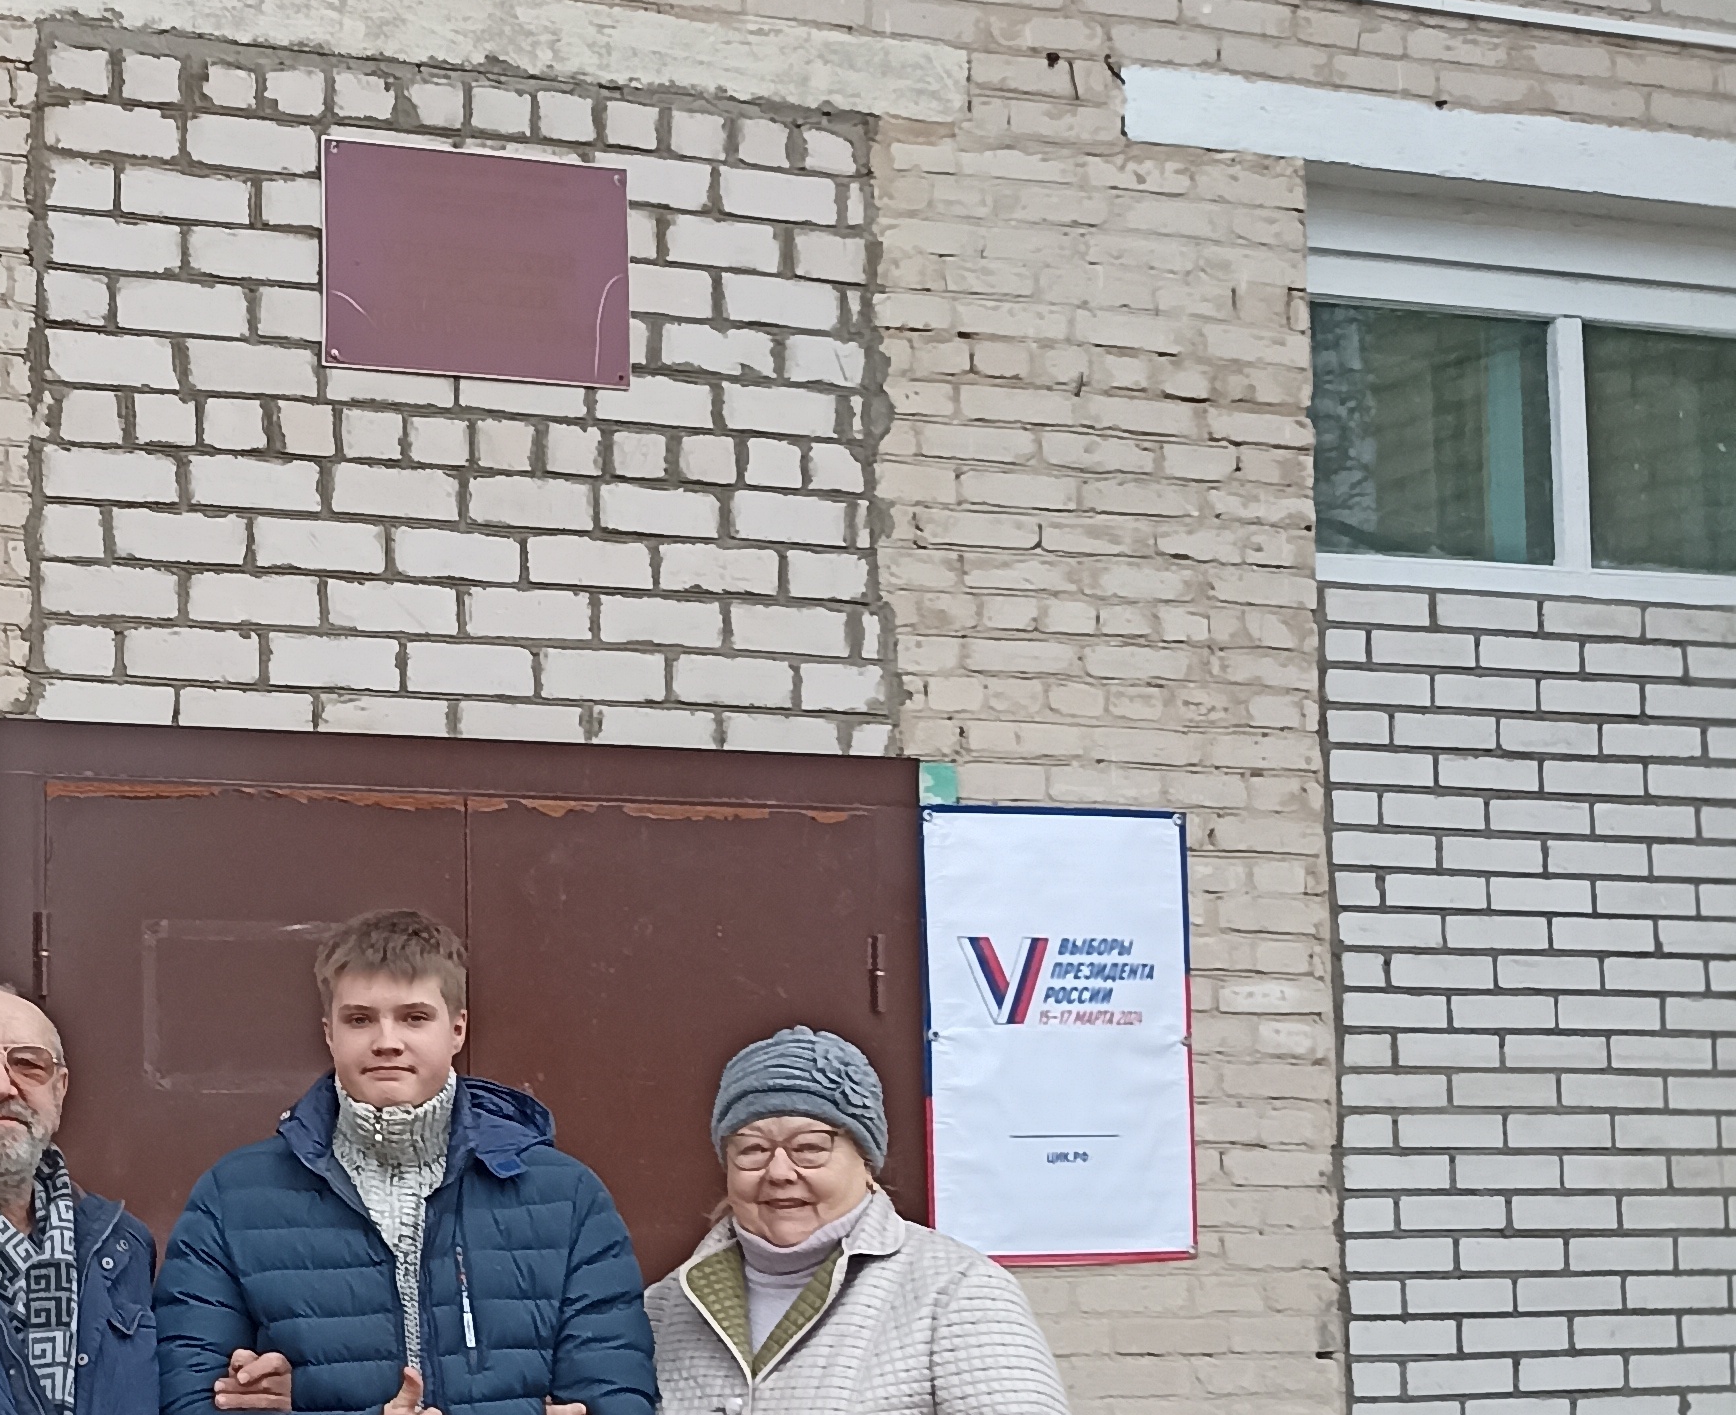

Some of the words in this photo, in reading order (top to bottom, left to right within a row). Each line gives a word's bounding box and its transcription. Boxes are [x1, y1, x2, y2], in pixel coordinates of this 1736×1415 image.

[1057, 937, 1134, 957] ВЫБОРЫ
[1050, 961, 1155, 983] ПРЕЗИДЕНТА
[1042, 986, 1114, 1004] РОССИИ
